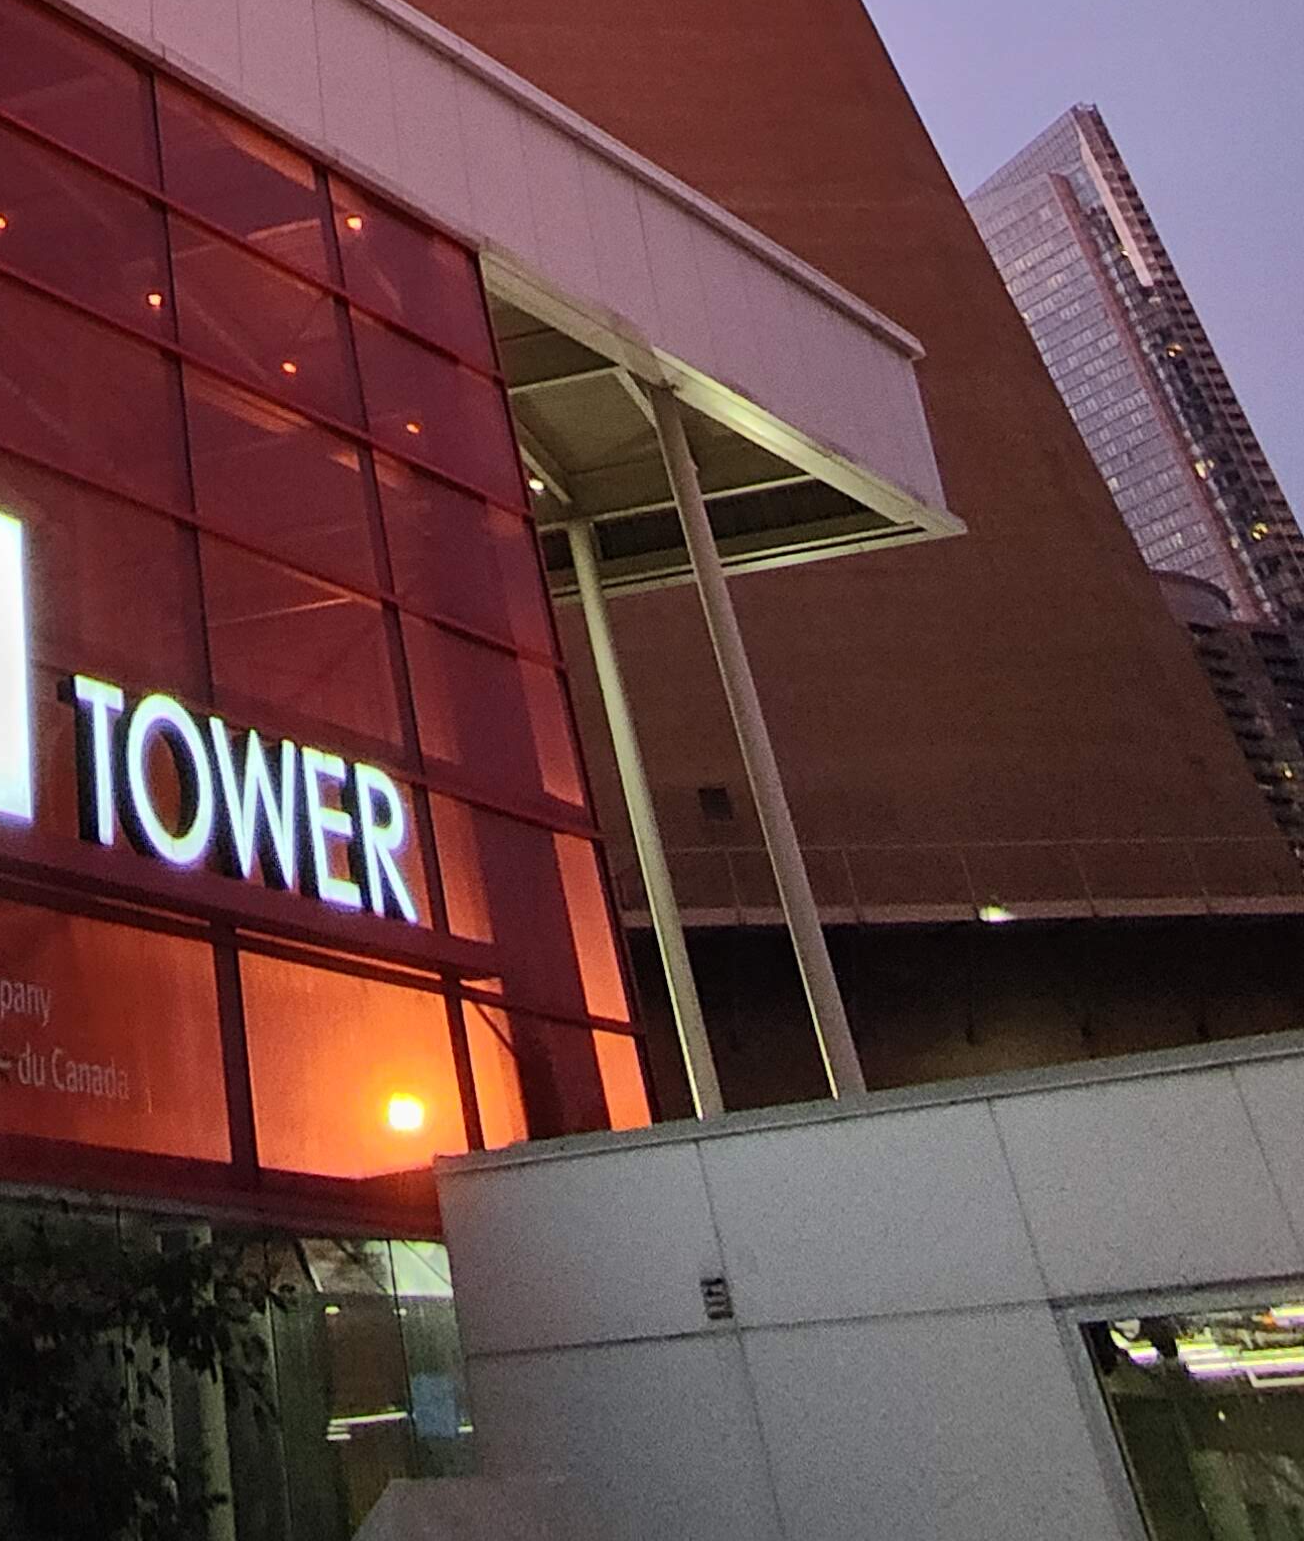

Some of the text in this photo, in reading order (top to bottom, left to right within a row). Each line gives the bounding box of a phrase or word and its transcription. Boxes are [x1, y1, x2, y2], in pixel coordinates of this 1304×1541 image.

[73, 674, 418, 924] TOWER
[17, 1042, 46, 1088] du
[51, 1047, 130, 1100] Canada
